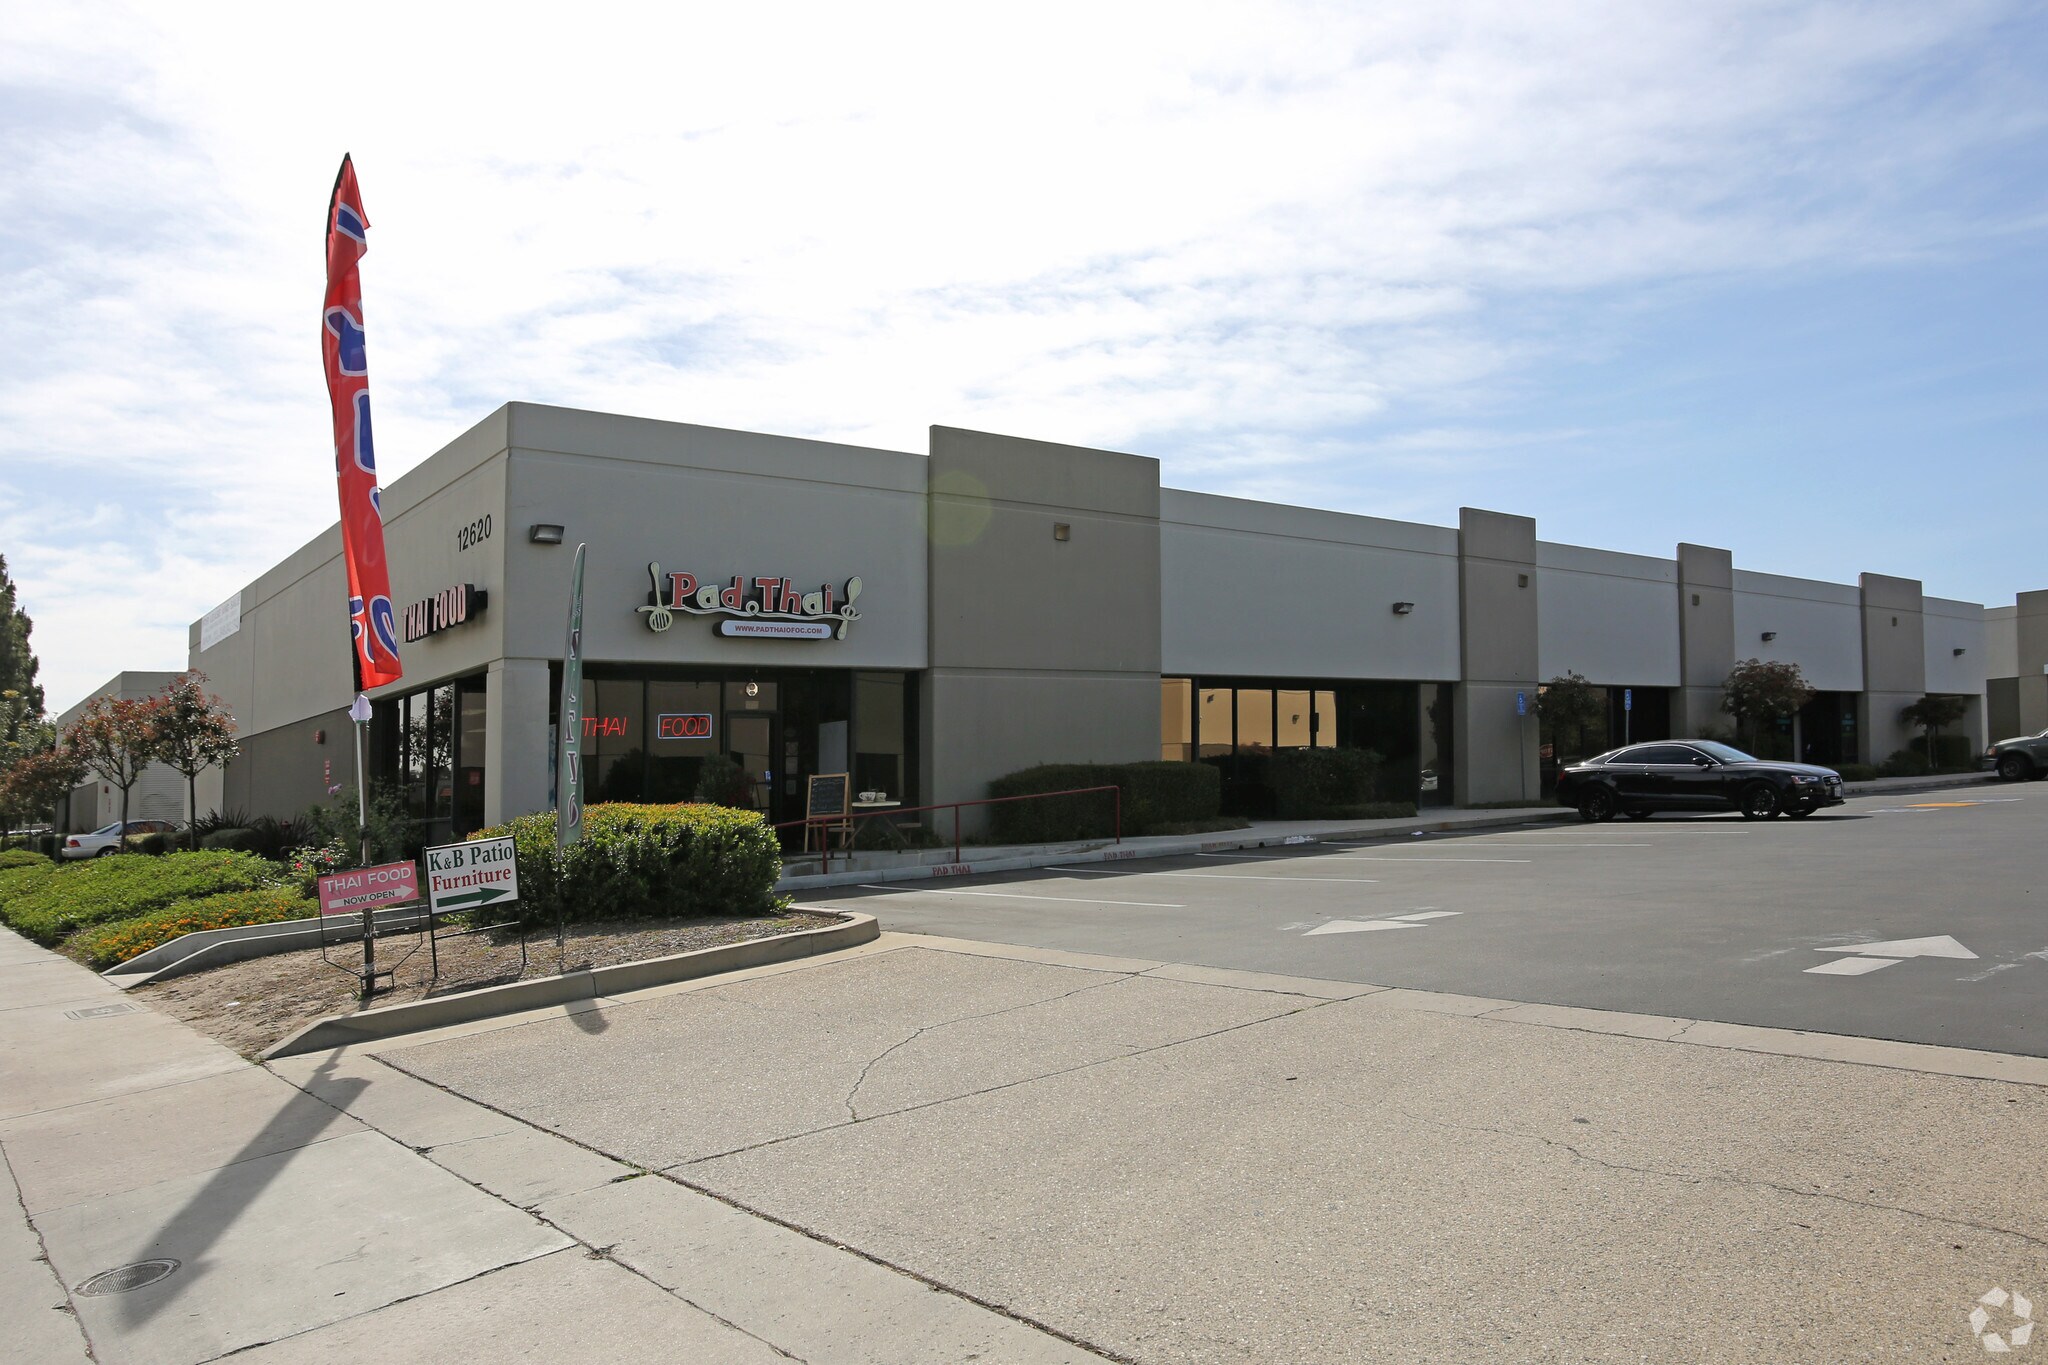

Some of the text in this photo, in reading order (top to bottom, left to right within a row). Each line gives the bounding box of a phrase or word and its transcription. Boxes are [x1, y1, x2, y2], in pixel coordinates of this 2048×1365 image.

[457, 513, 492, 553] 12620
[669, 571, 834, 615] Pad Thai
[401, 583, 467, 643] THAI FOOD
[734, 625, 823, 635] WWW.PADTHAIOFOC.COM
[581, 716, 710, 737] THAI FOOD
[428, 843, 513, 872] K&B Patio
[932, 864, 971, 876] PAD THAI
[324, 867, 412, 893] THAI FOOD
[432, 867, 512, 892] Furniture
[343, 889, 396, 906] NOW OPEN
